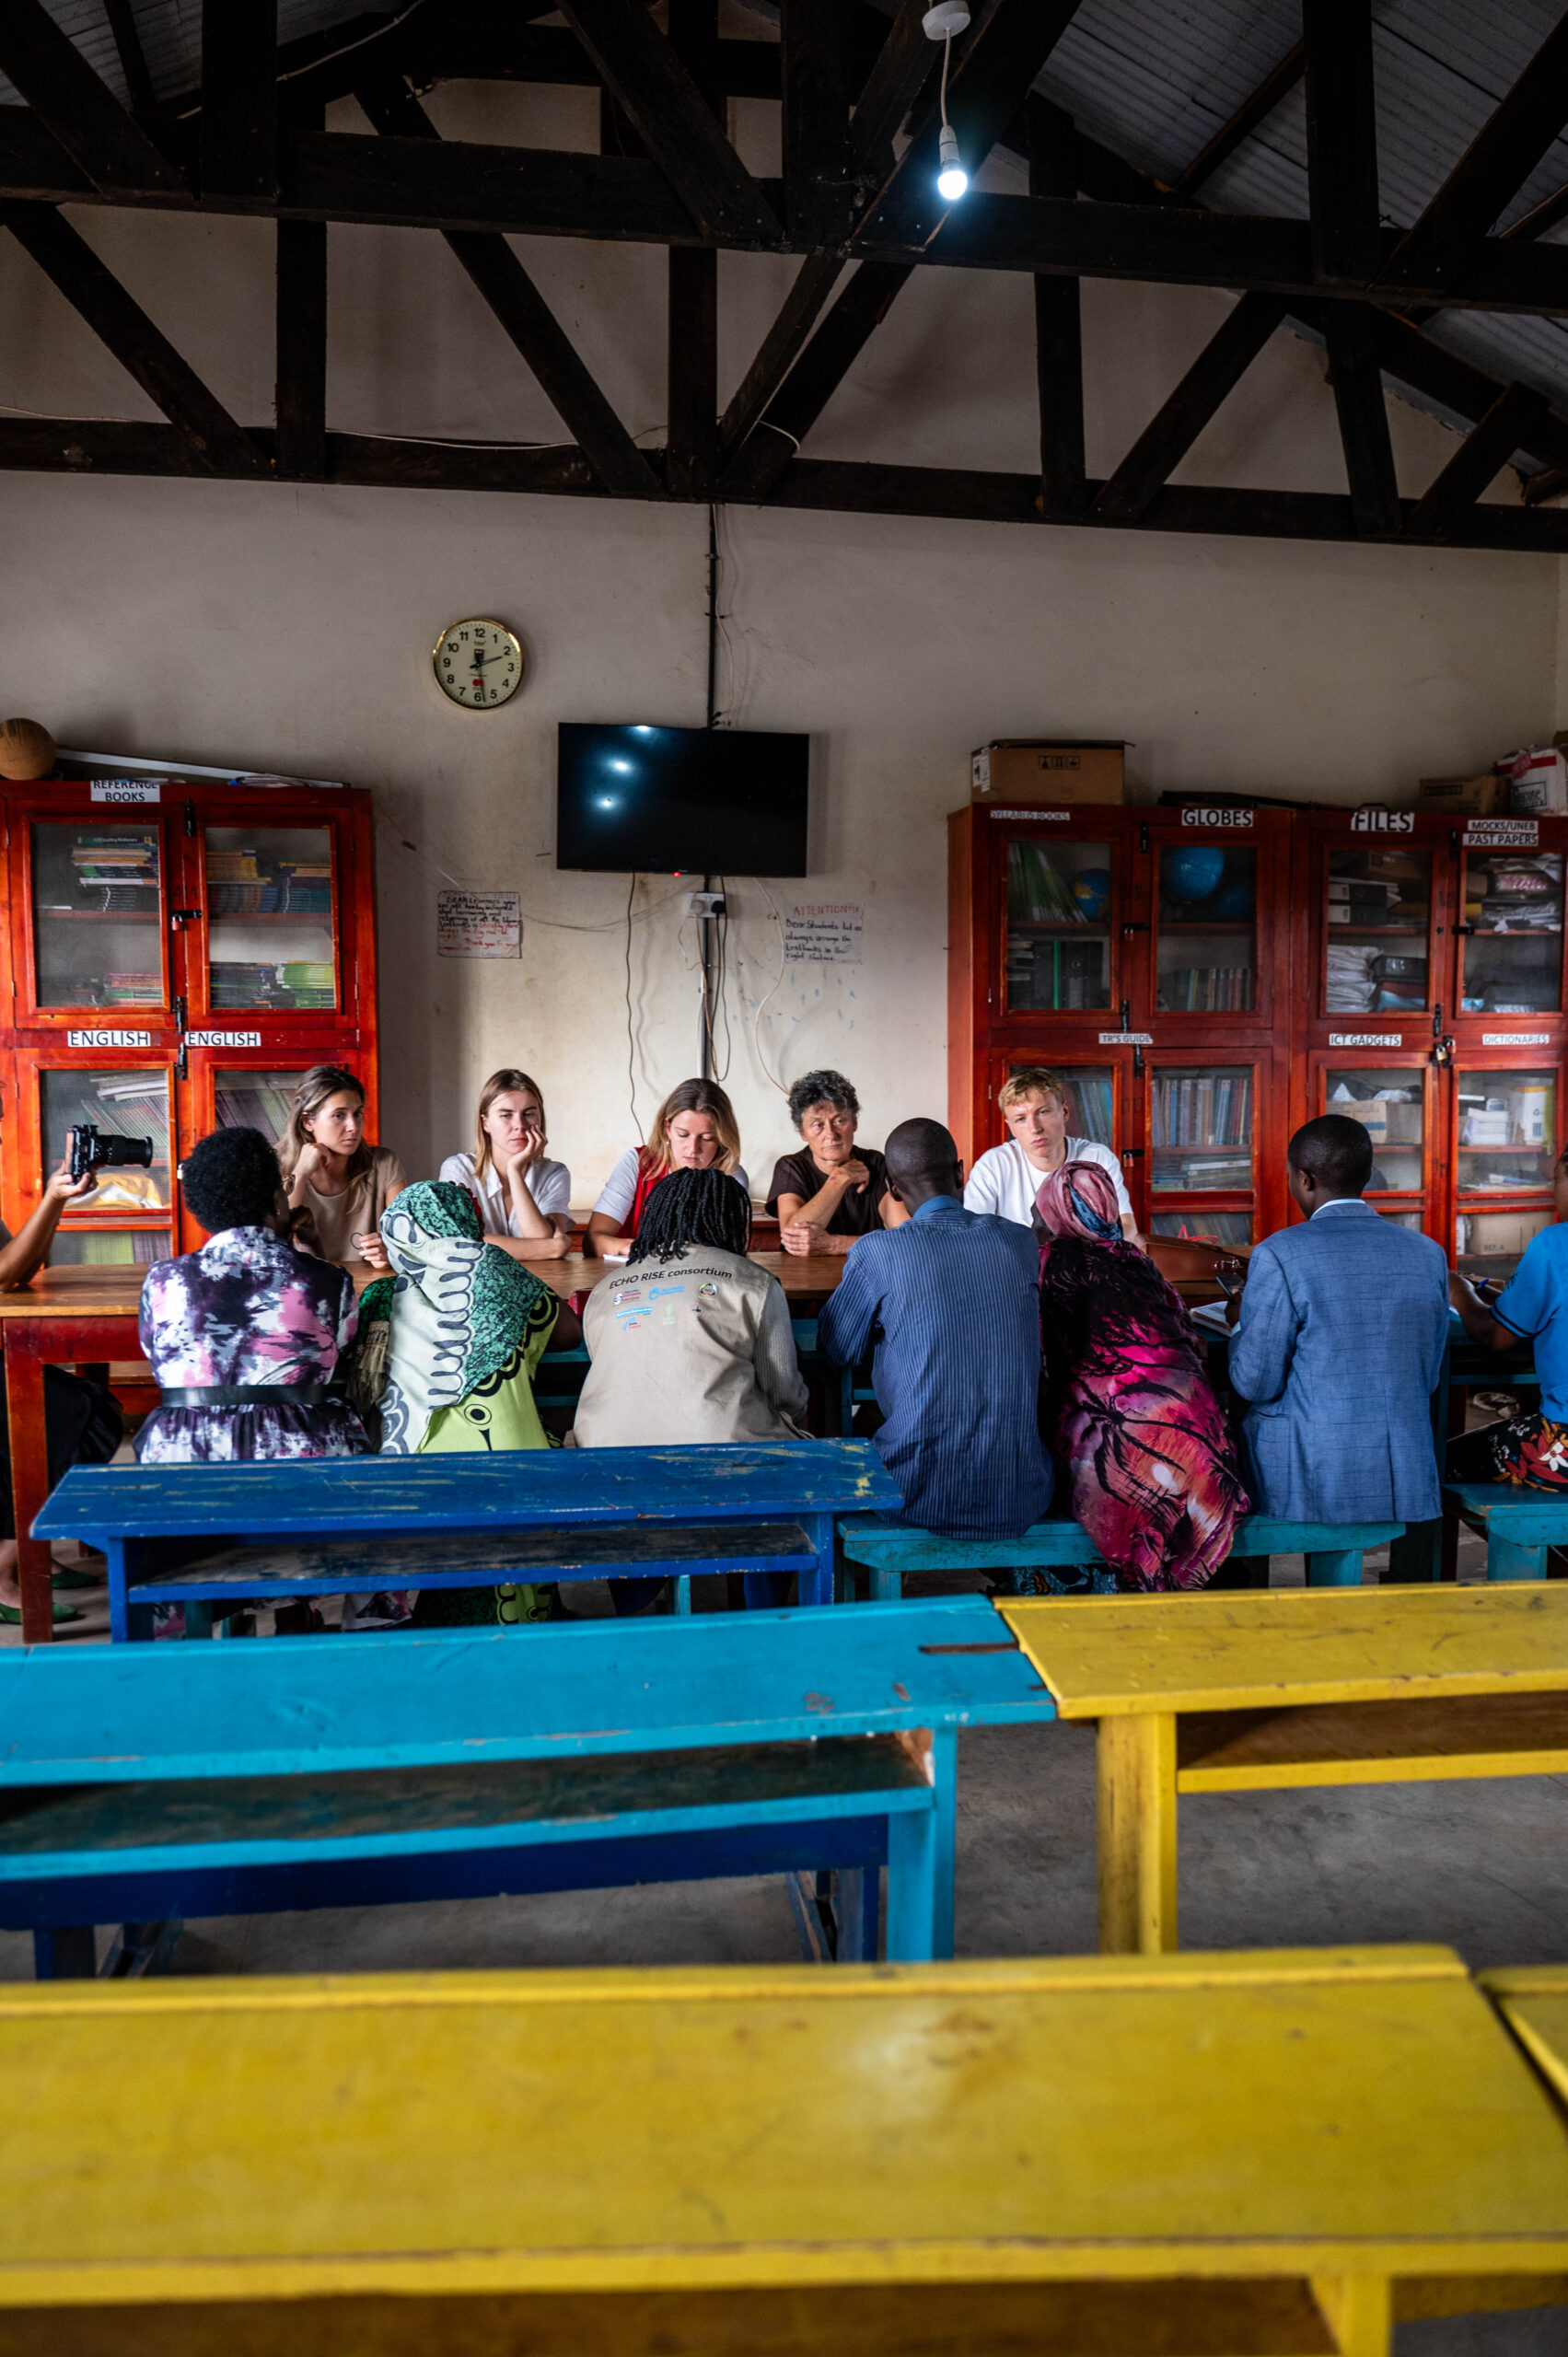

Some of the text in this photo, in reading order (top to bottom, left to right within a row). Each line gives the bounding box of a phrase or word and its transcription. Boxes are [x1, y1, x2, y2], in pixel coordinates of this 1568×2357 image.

[459, 632, 469, 641] 11
[474, 628, 485, 638] 12
[493, 633, 498, 644] 1
[447, 643, 459, 653] 10
[504, 646, 511, 656] 2
[443, 657, 450, 668] 9
[507, 663, 515, 672] 3
[447, 674, 455, 684] 8
[502, 679, 509, 688] 4
[459, 686, 467, 696] 7
[490, 690, 497, 699] 5
[474, 692, 482, 702] 6
[105, 792, 145, 802] BOOKS
[1037, 811, 1068, 820] BOOKS
[1183, 809, 1252, 826] GLOBES
[1355, 812, 1411, 831] FILES
[1472, 821, 1536, 832] MOCKS/UNEB
[1469, 834, 1538, 845] PAST PAPERS
[70, 1031, 149, 1046] ENGLISH
[188, 1032, 258, 1046] ENGLISH
[1102, 1035, 1151, 1043] TR'S GUIDE
[1330, 1035, 1400, 1046] ICT GADGETS
[1484, 1035, 1547, 1044] DICTIONARIES
[609, 1267, 733, 1289] ECHO RISE consortium
